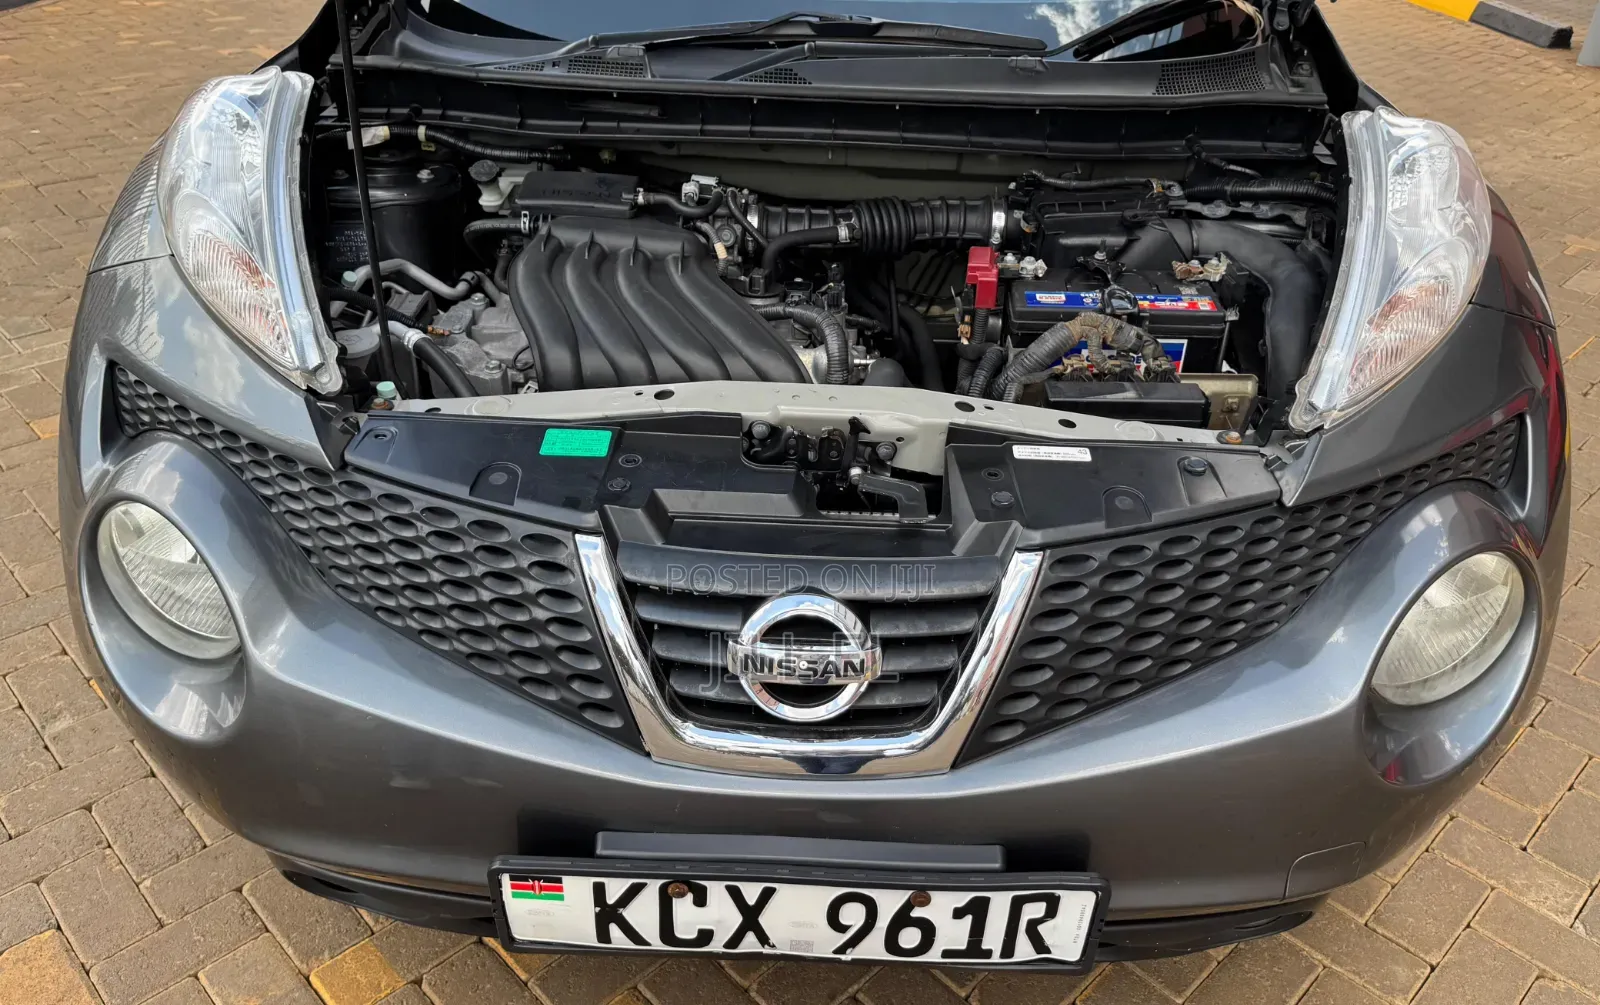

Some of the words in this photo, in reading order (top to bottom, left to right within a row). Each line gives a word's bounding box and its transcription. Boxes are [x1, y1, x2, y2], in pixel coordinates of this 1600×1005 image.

[743, 653, 866, 681] NISSAN
[592, 880, 779, 950] KCX
[825, 891, 1061, 959] 961R
